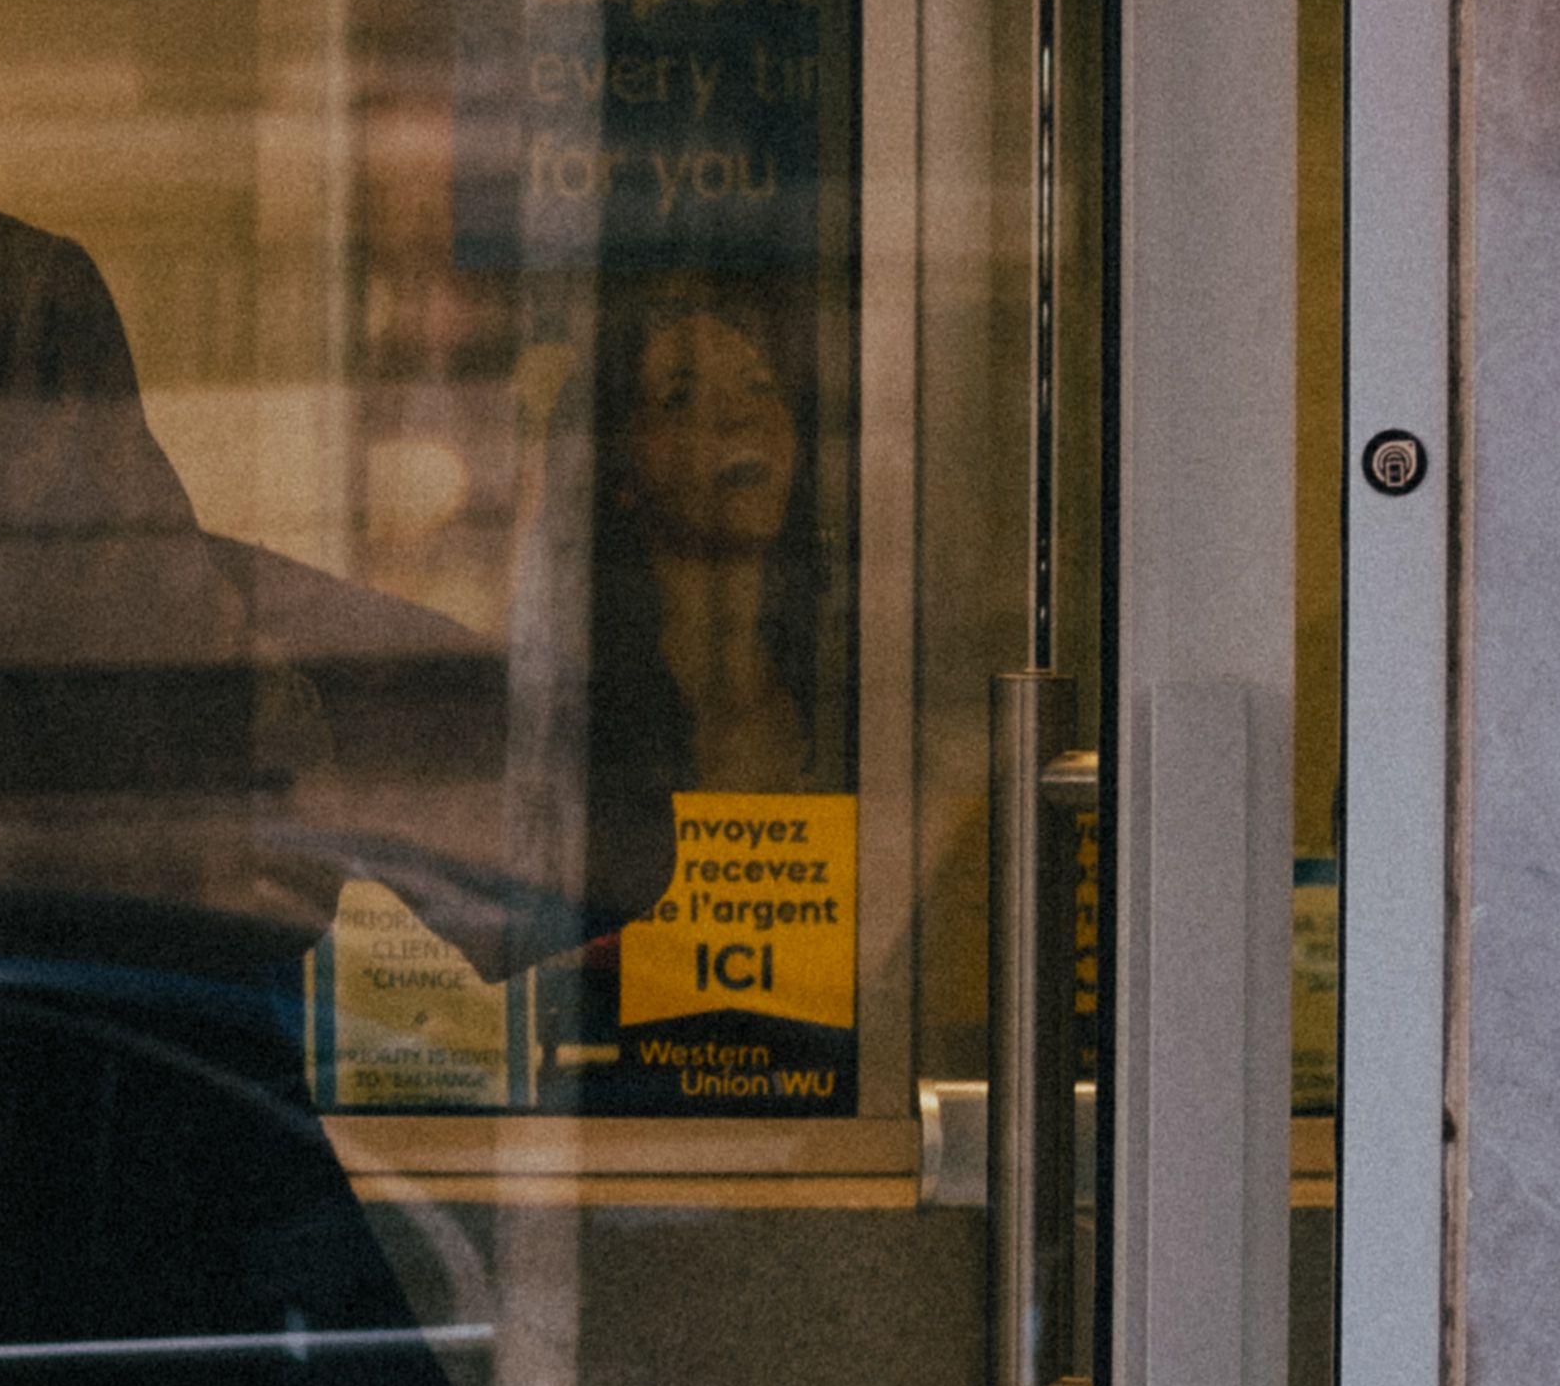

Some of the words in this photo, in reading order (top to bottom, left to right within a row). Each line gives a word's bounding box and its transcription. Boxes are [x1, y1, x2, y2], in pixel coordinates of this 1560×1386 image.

[530, 53, 721, 119] every
[530, 132, 626, 198] for
[652, 149, 778, 217] you
[679, 818, 809, 851] nvoyez
[684, 860, 829, 883] recevez
[691, 892, 838, 931] l'argent
[696, 943, 773, 992] ICI
[640, 1039, 770, 1066] Western
[681, 1070, 769, 1096] Union
[782, 1070, 836, 1098] WU
